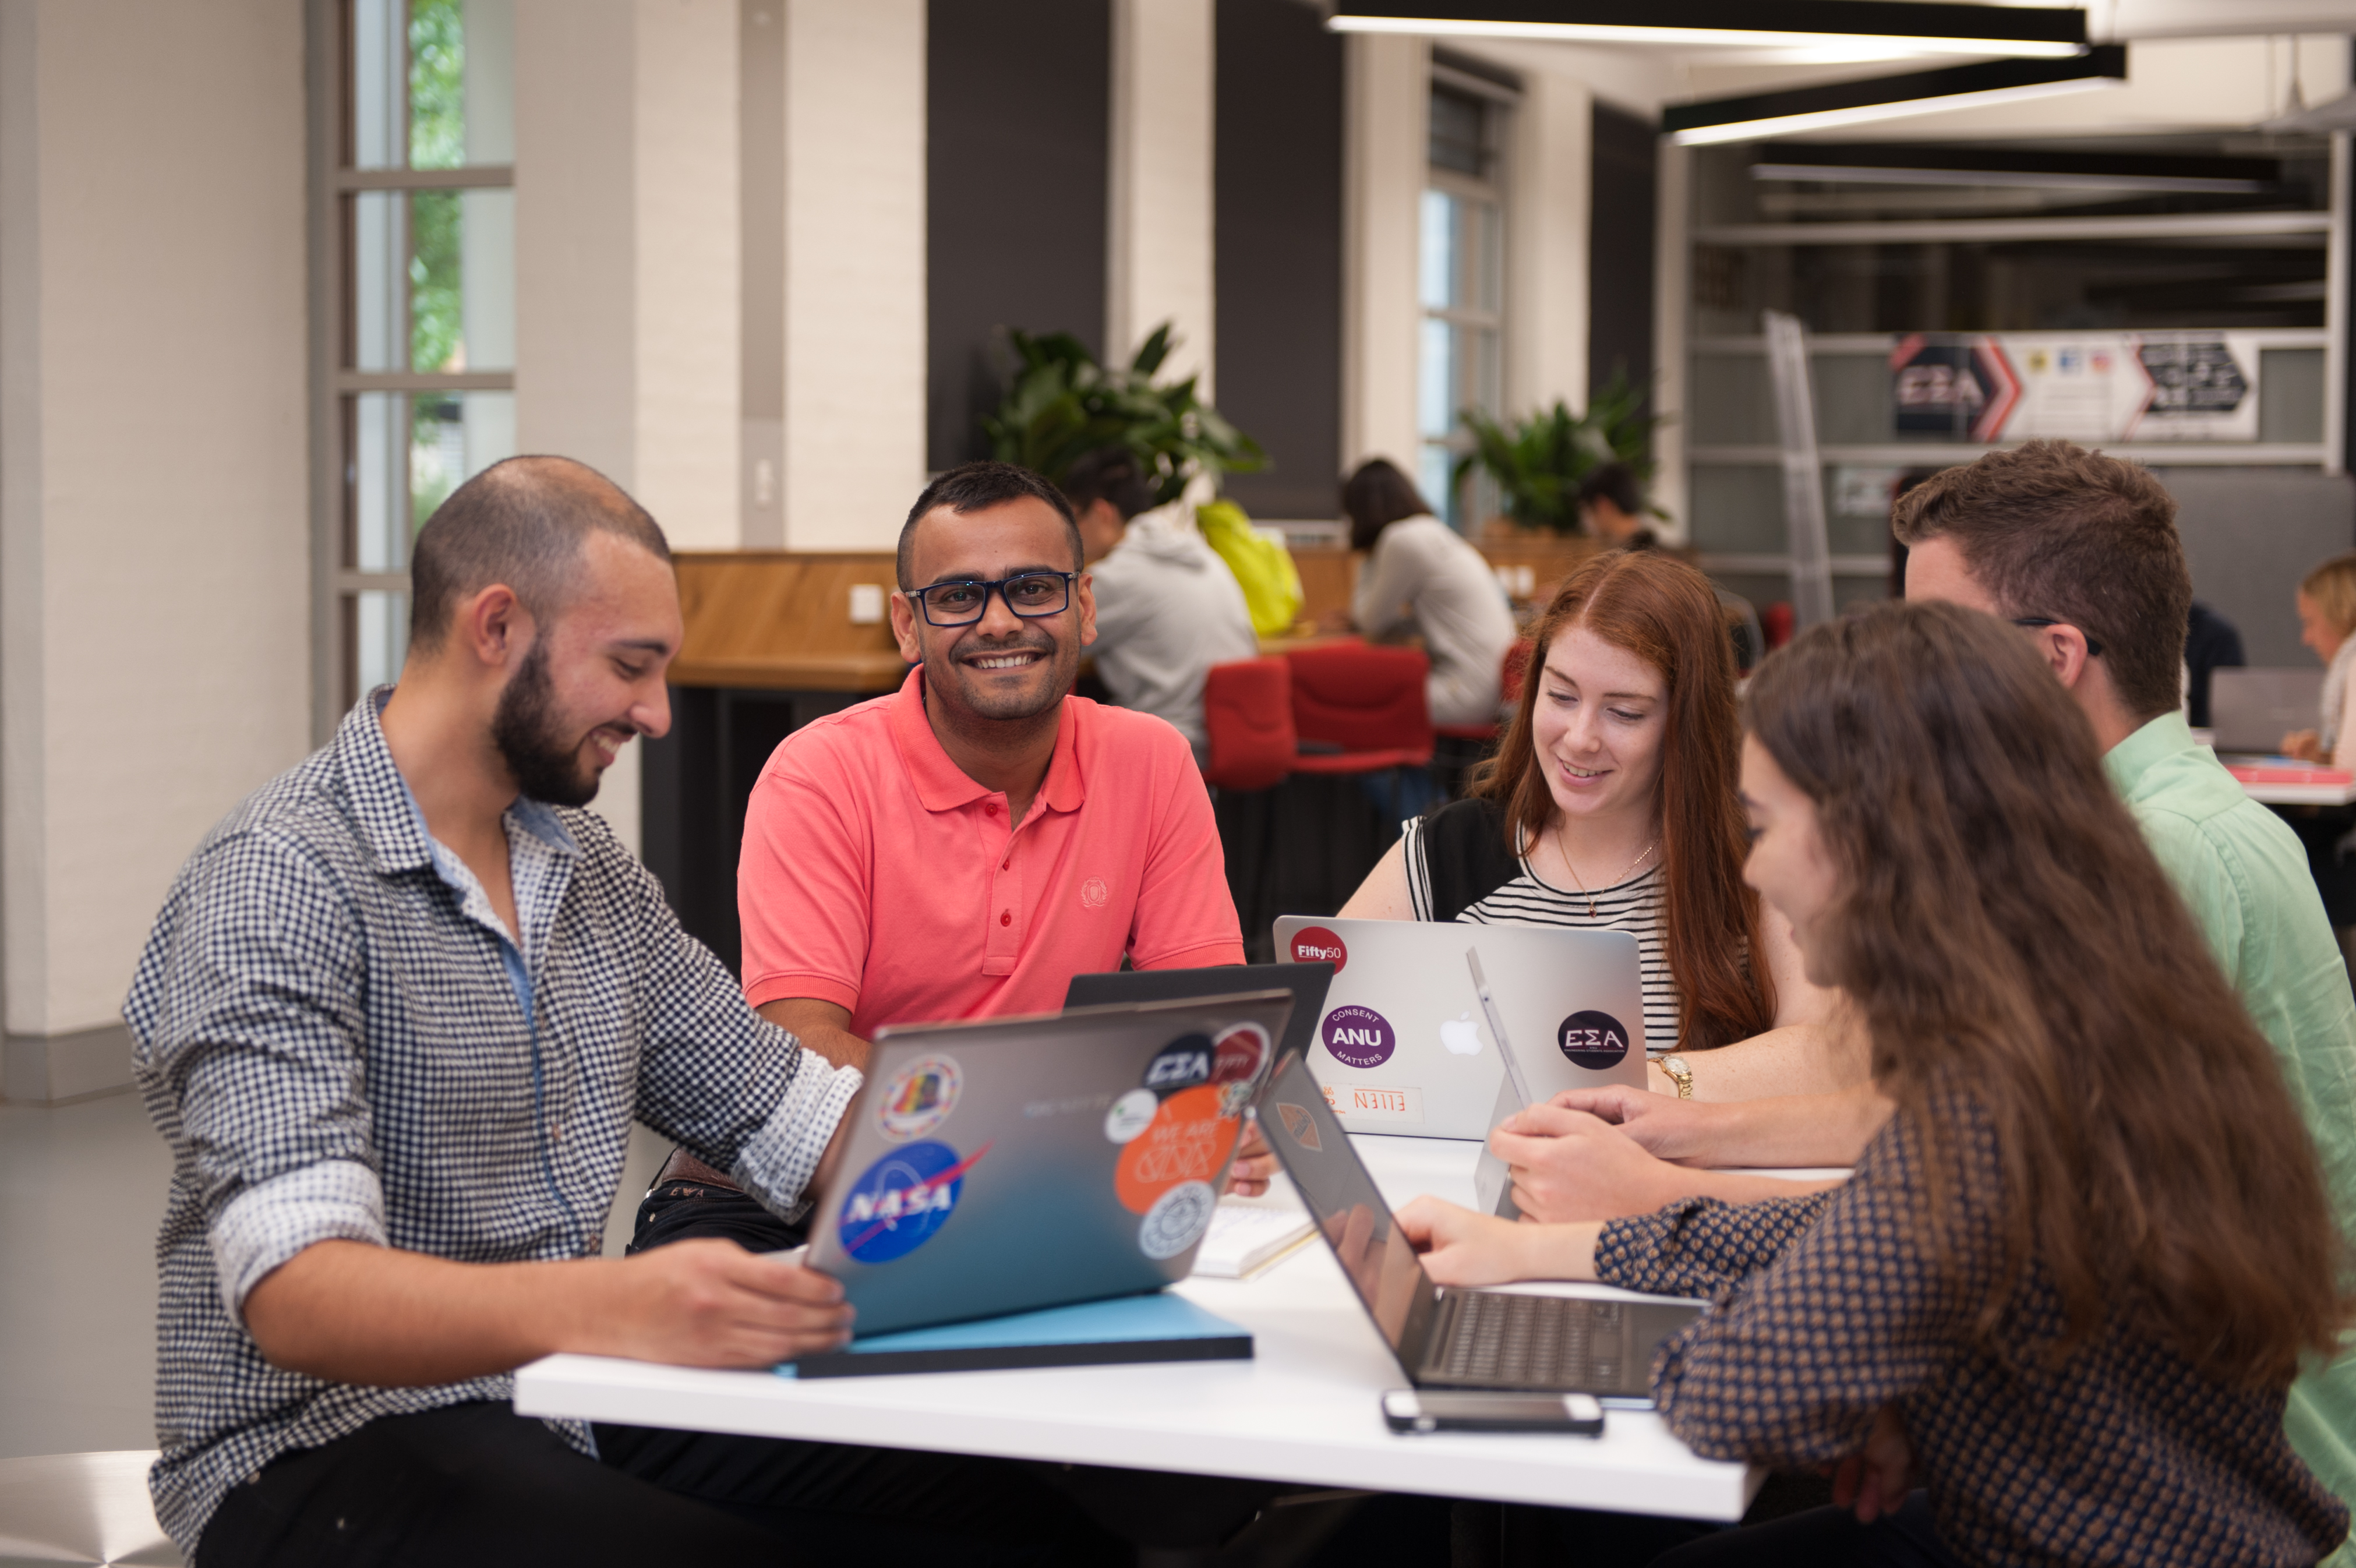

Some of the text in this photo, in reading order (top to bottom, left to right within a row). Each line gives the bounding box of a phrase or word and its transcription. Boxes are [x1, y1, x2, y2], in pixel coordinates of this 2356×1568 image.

[1298, 945, 1341, 959] Fifty50
[1332, 1008, 1379, 1023] CONSENT
[1332, 1027, 1382, 1047] ANU
[1337, 1051, 1383, 1065] MATTERS
[846, 1183, 952, 1223] NASA
